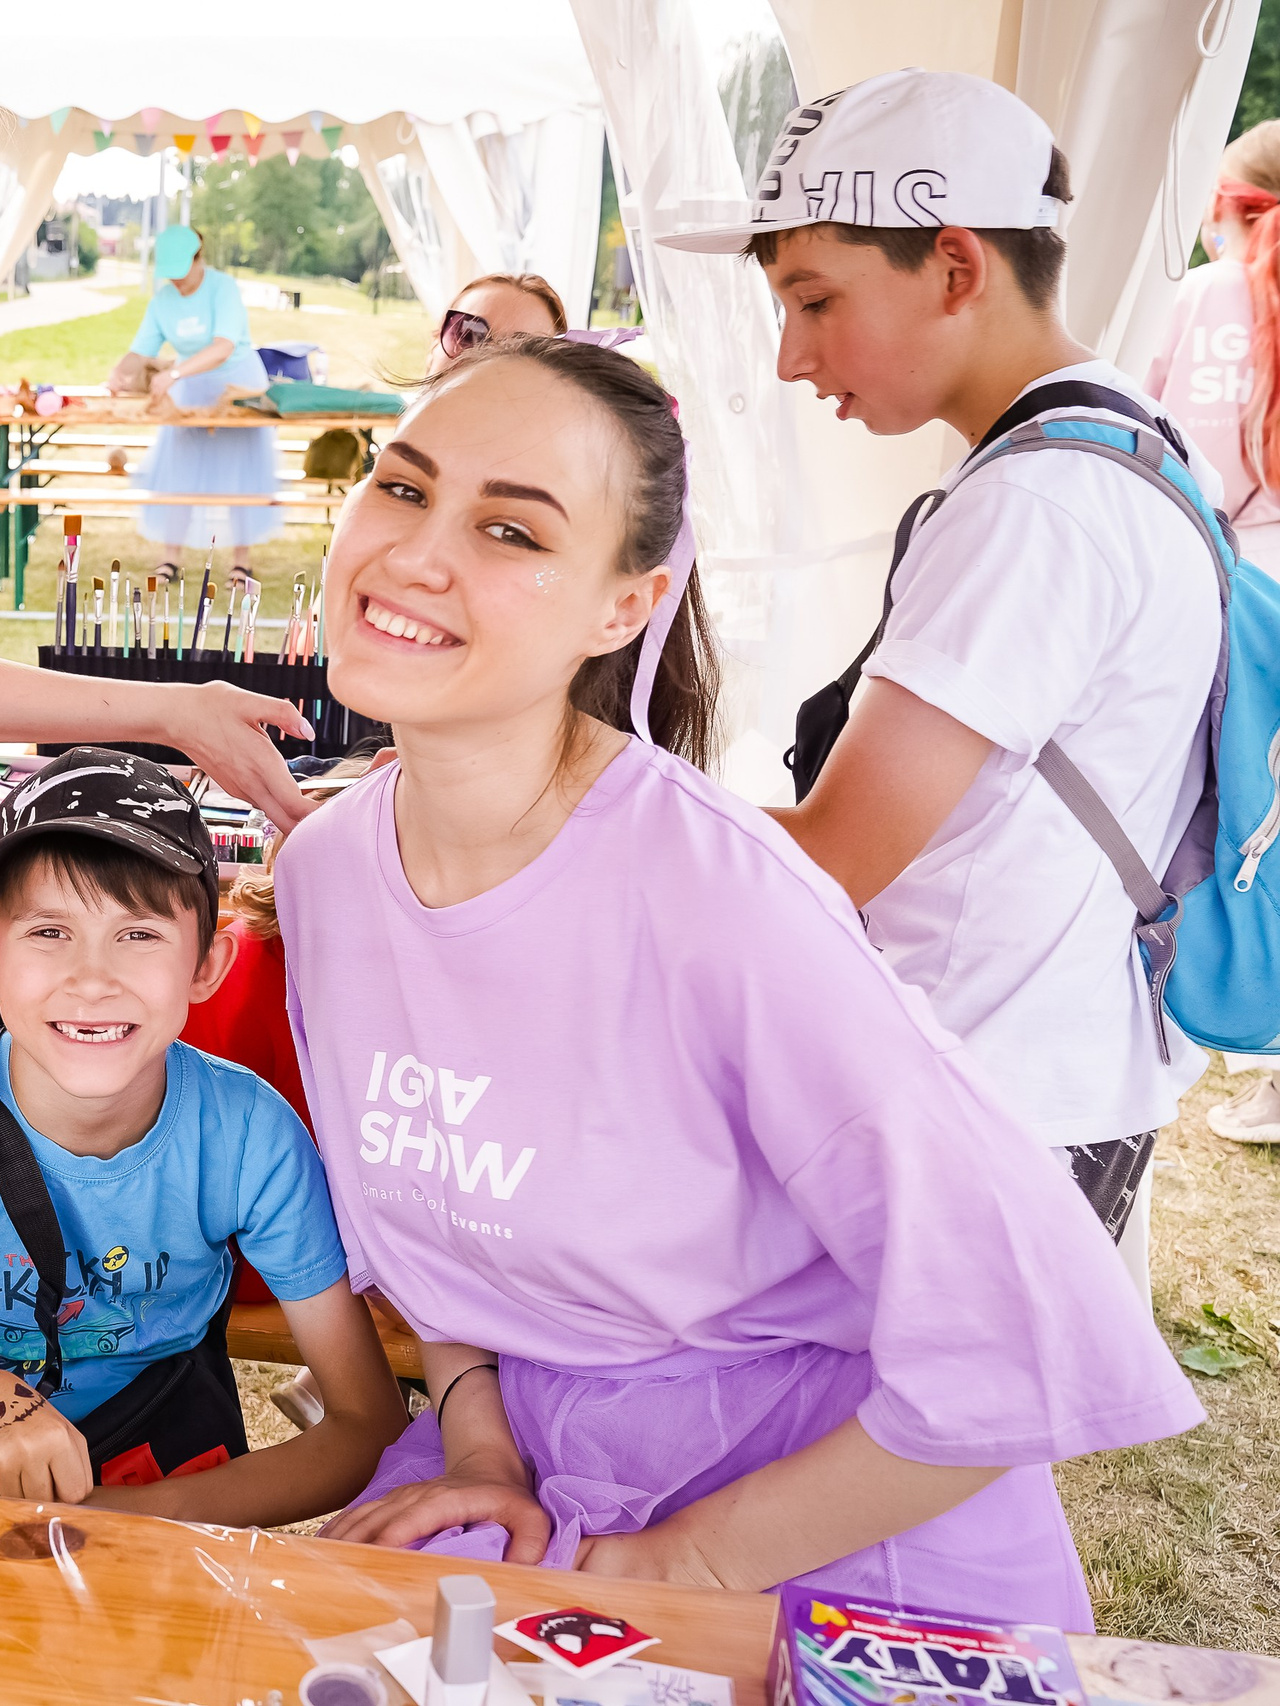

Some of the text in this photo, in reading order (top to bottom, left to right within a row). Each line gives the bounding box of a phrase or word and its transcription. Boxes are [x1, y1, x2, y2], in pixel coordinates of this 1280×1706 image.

[1192, 323, 1251, 363] IG
[1189, 365, 1255, 405] SH
[362, 1182, 403, 1202] Smart
[449, 1210, 514, 1240] Events
